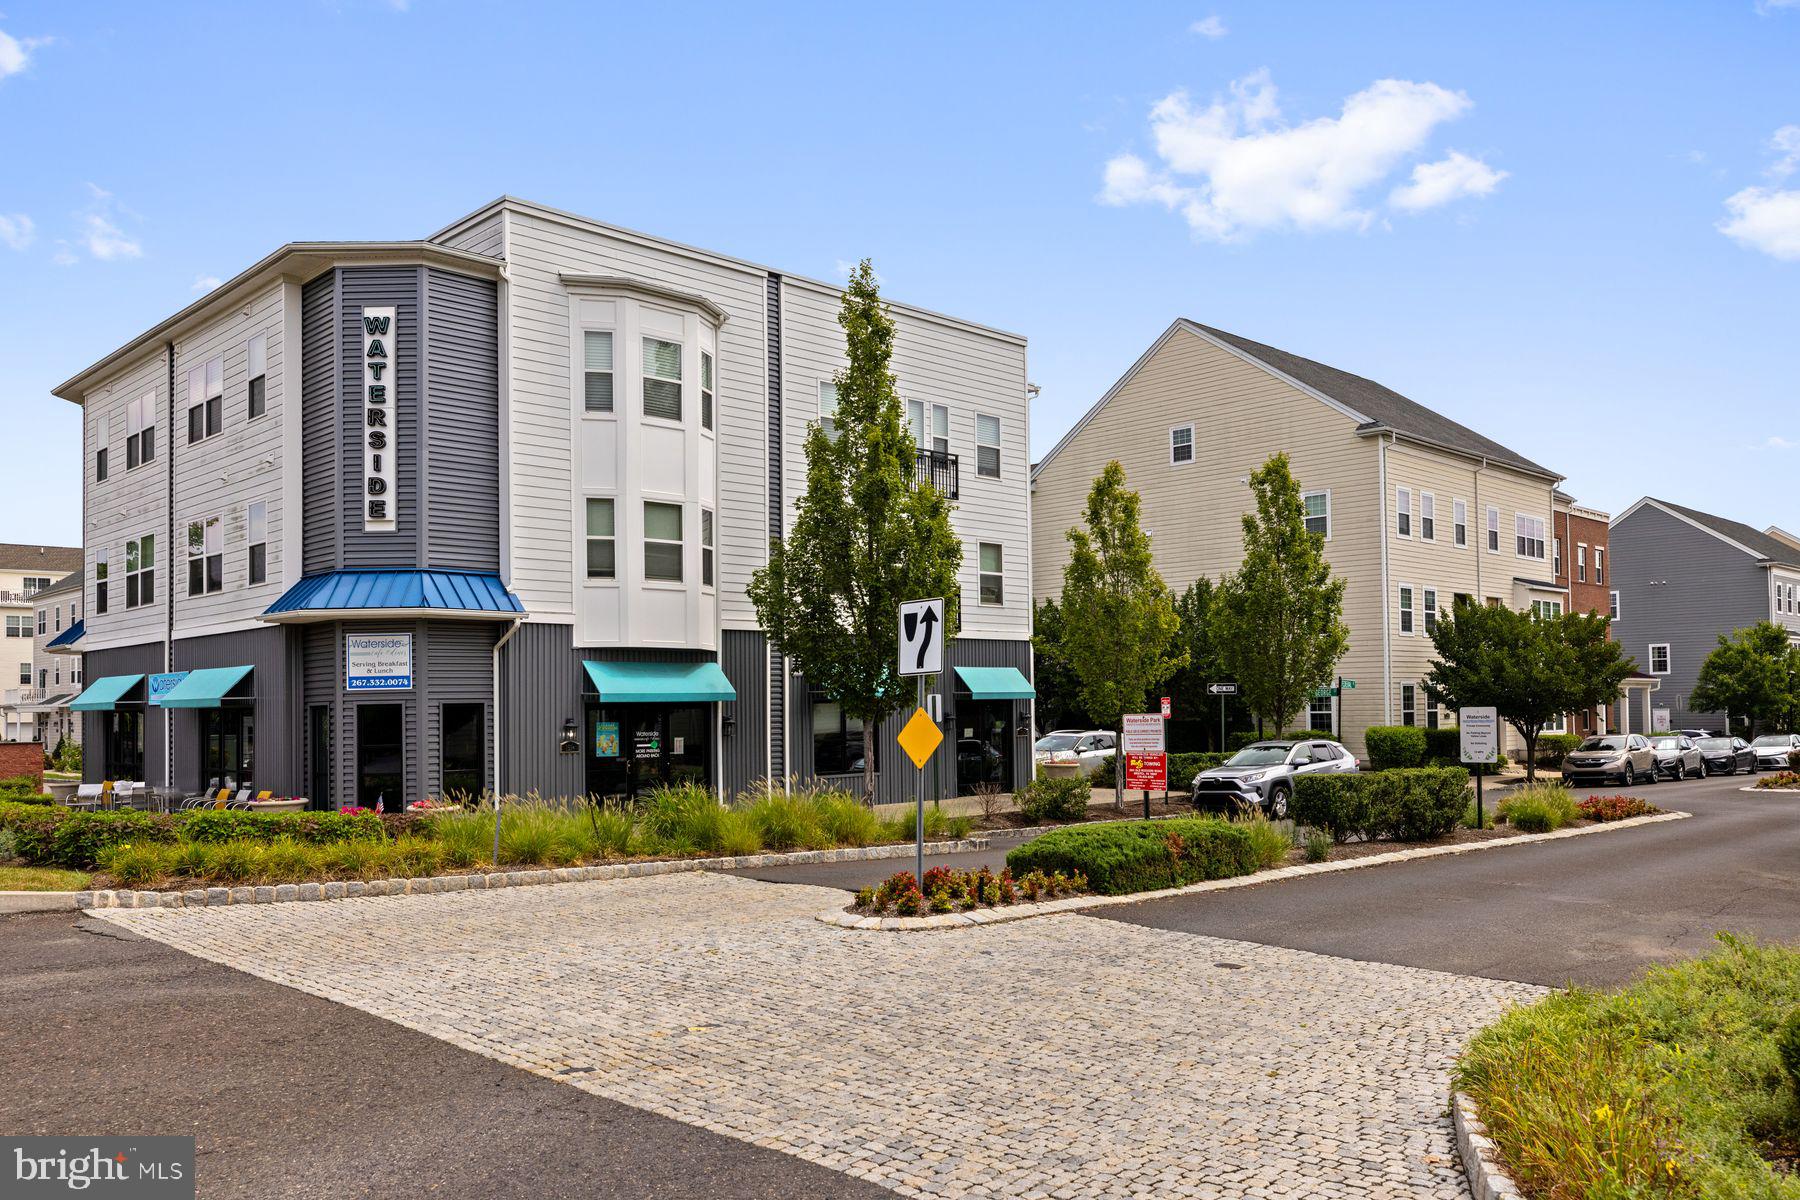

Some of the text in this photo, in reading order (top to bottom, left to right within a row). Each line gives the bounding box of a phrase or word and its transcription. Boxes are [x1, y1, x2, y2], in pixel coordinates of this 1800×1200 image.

[364, 316, 390, 518] WATERSIDE
[351, 638, 402, 648] Waterside
[351, 678, 409, 686] 267.332.0074
